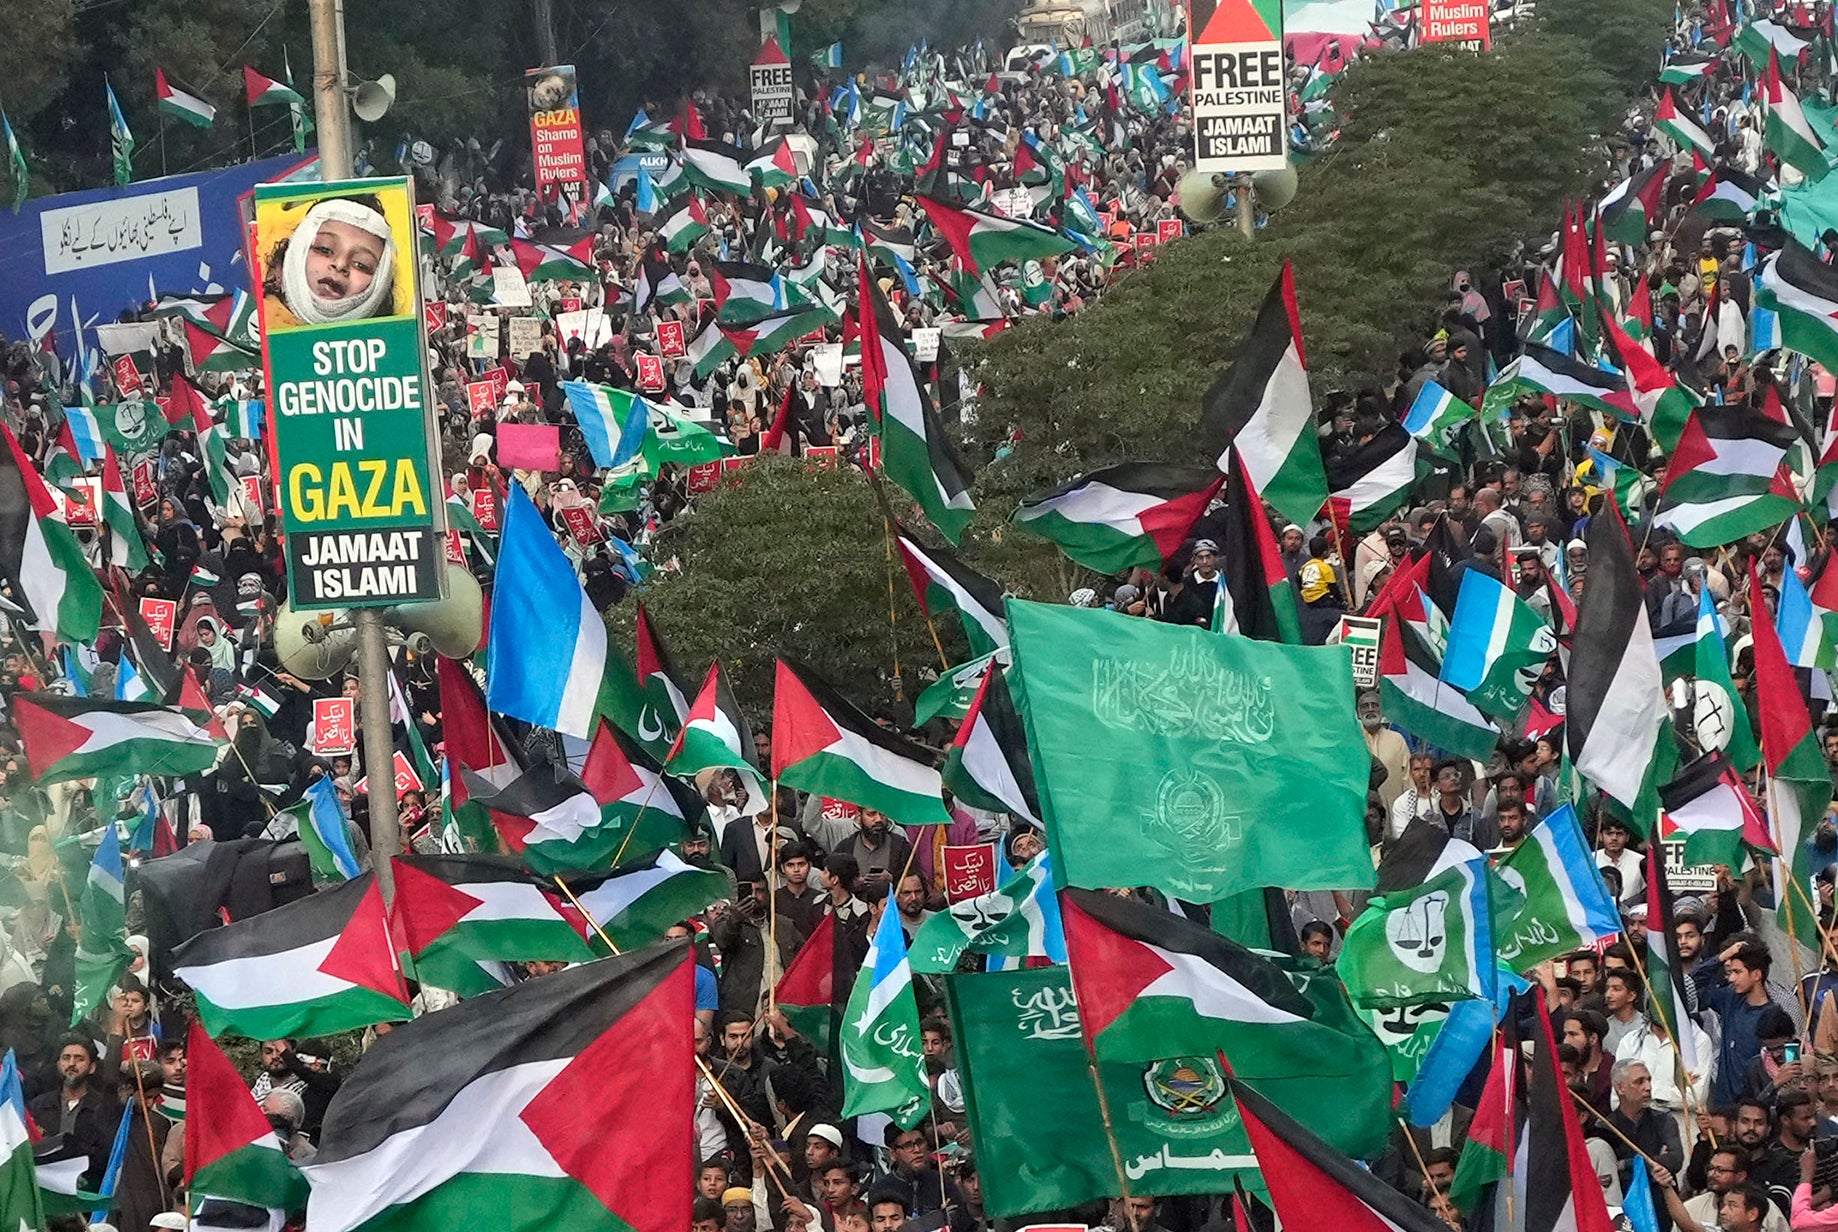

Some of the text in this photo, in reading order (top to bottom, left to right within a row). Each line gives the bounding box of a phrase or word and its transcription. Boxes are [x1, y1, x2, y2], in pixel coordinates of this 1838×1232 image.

[1430, 4, 1483, 20] Muslim
[1431, 21, 1478, 36] Rulers
[752, 68, 791, 86] FREE
[1193, 50, 1281, 89] FREE
[1194, 89, 1281, 106] PALESTINE
[534, 109, 576, 127] GAZA
[1203, 116, 1275, 137] JAMAAT
[536, 128, 577, 143] Shame
[537, 143, 552, 153] on
[1210, 135, 1271, 156] ISLAMI
[538, 153, 581, 168] Muslim
[640, 157, 668, 166] ALKH
[540, 167, 577, 180] Rulers
[312, 339, 385, 375] STOP
[279, 376, 421, 416] GENOCIDE
[333, 418, 363, 451] IN
[289, 458, 427, 523] GAZA
[302, 531, 422, 567] JAMAAT
[313, 565, 417, 599] ISLAMI
[1126, 1143, 1260, 1181] ماس
